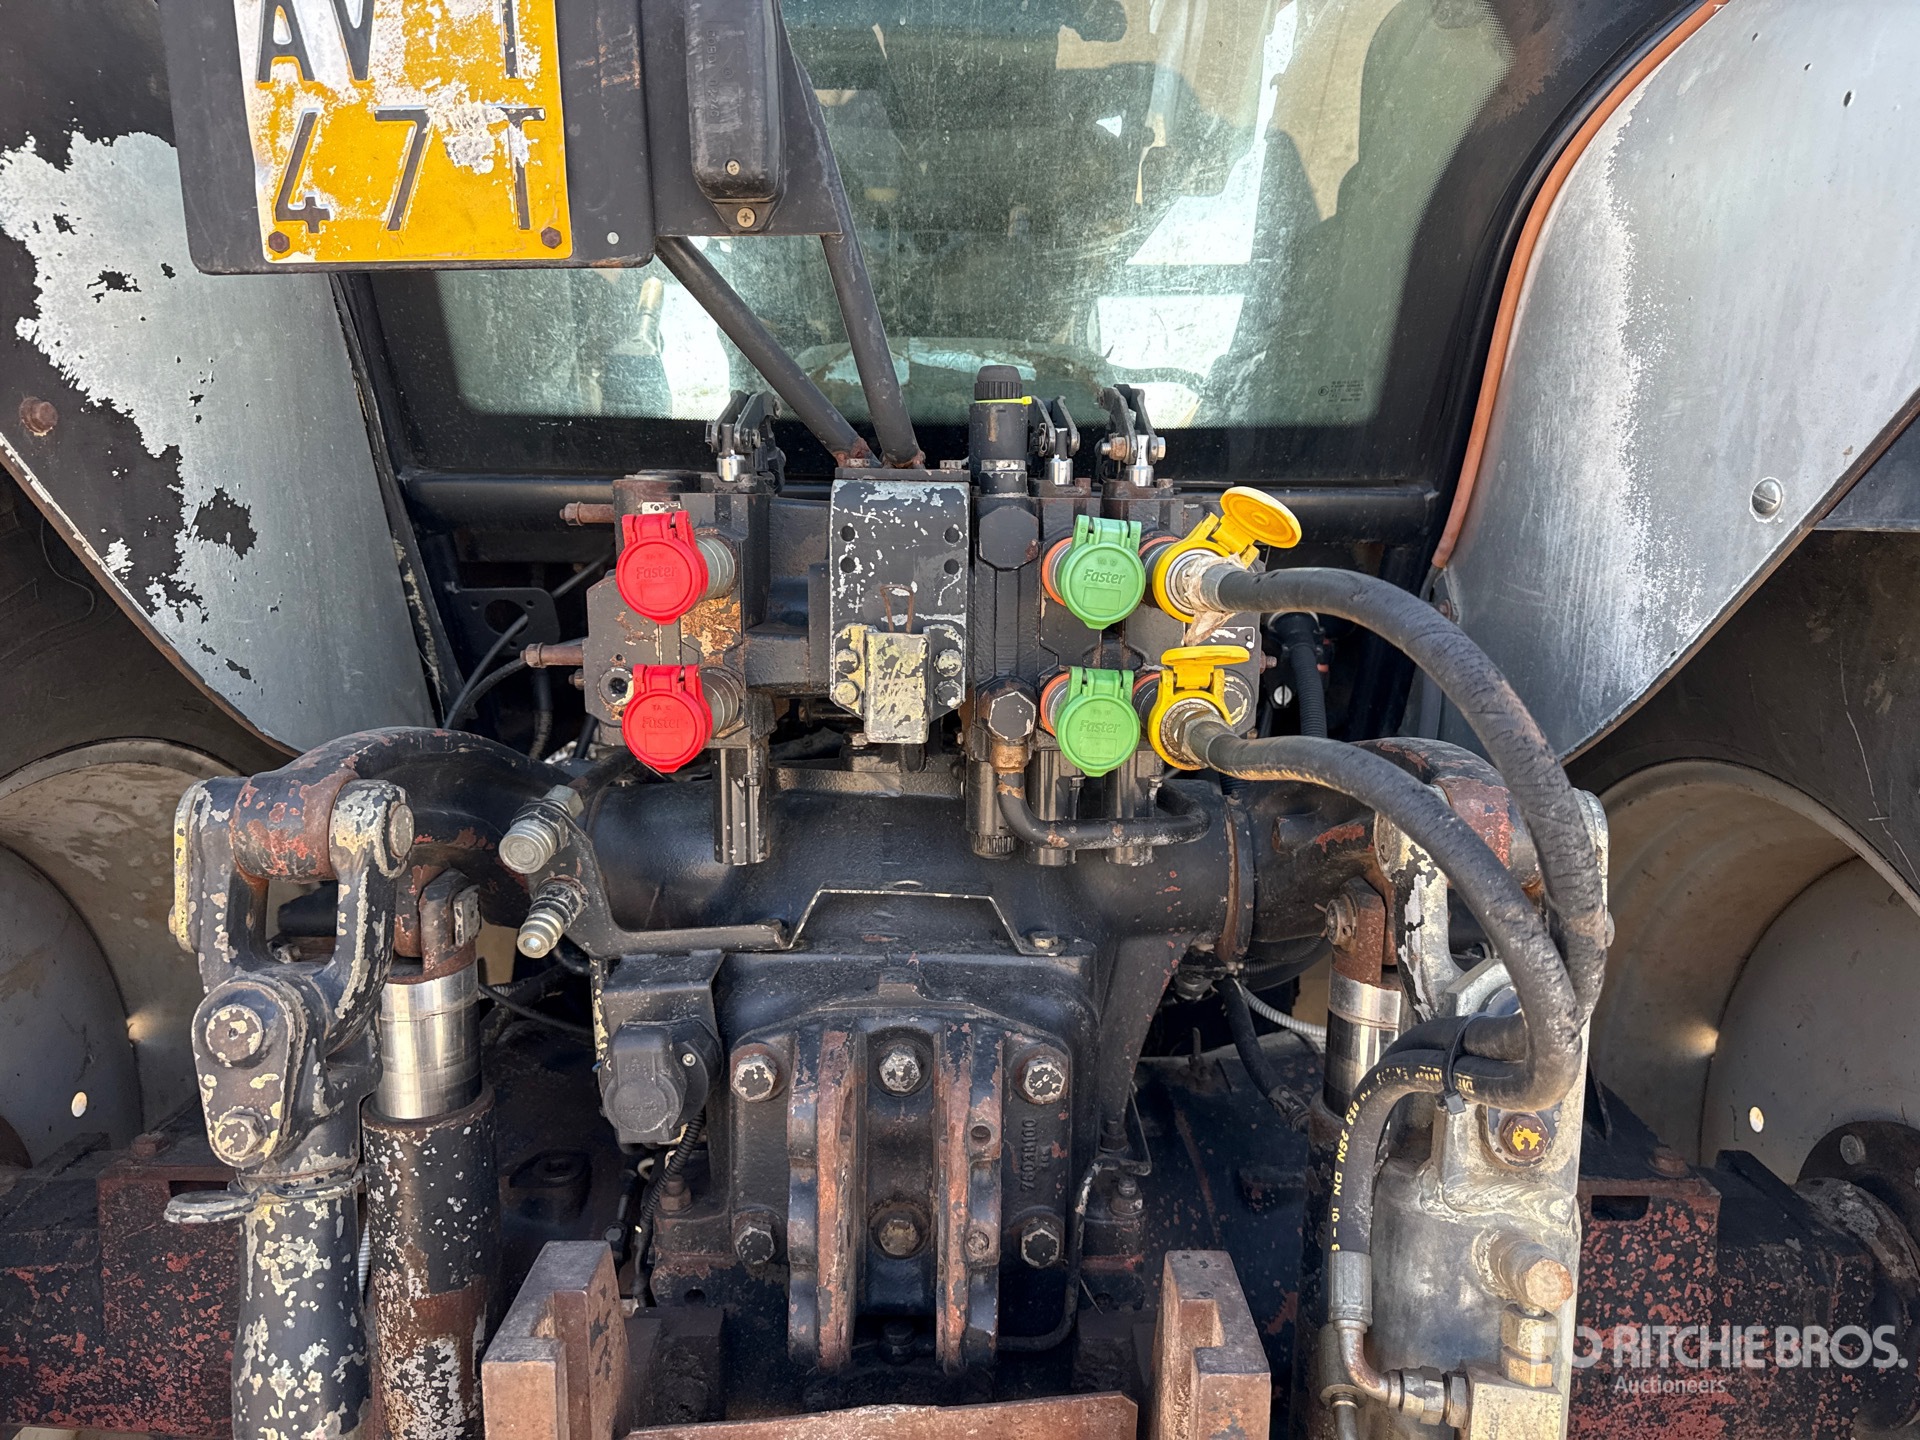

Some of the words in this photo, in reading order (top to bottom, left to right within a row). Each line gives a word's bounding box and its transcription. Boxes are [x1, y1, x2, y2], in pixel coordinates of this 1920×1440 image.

[636, 565, 678, 580] Faster
[1083, 568, 1127, 586] Faster
[642, 715, 680, 730] Faster
[1079, 719, 1121, 734] Faster
[1337, 1129, 1349, 1163] 2SN
[1333, 1171, 1343, 1196] DN
